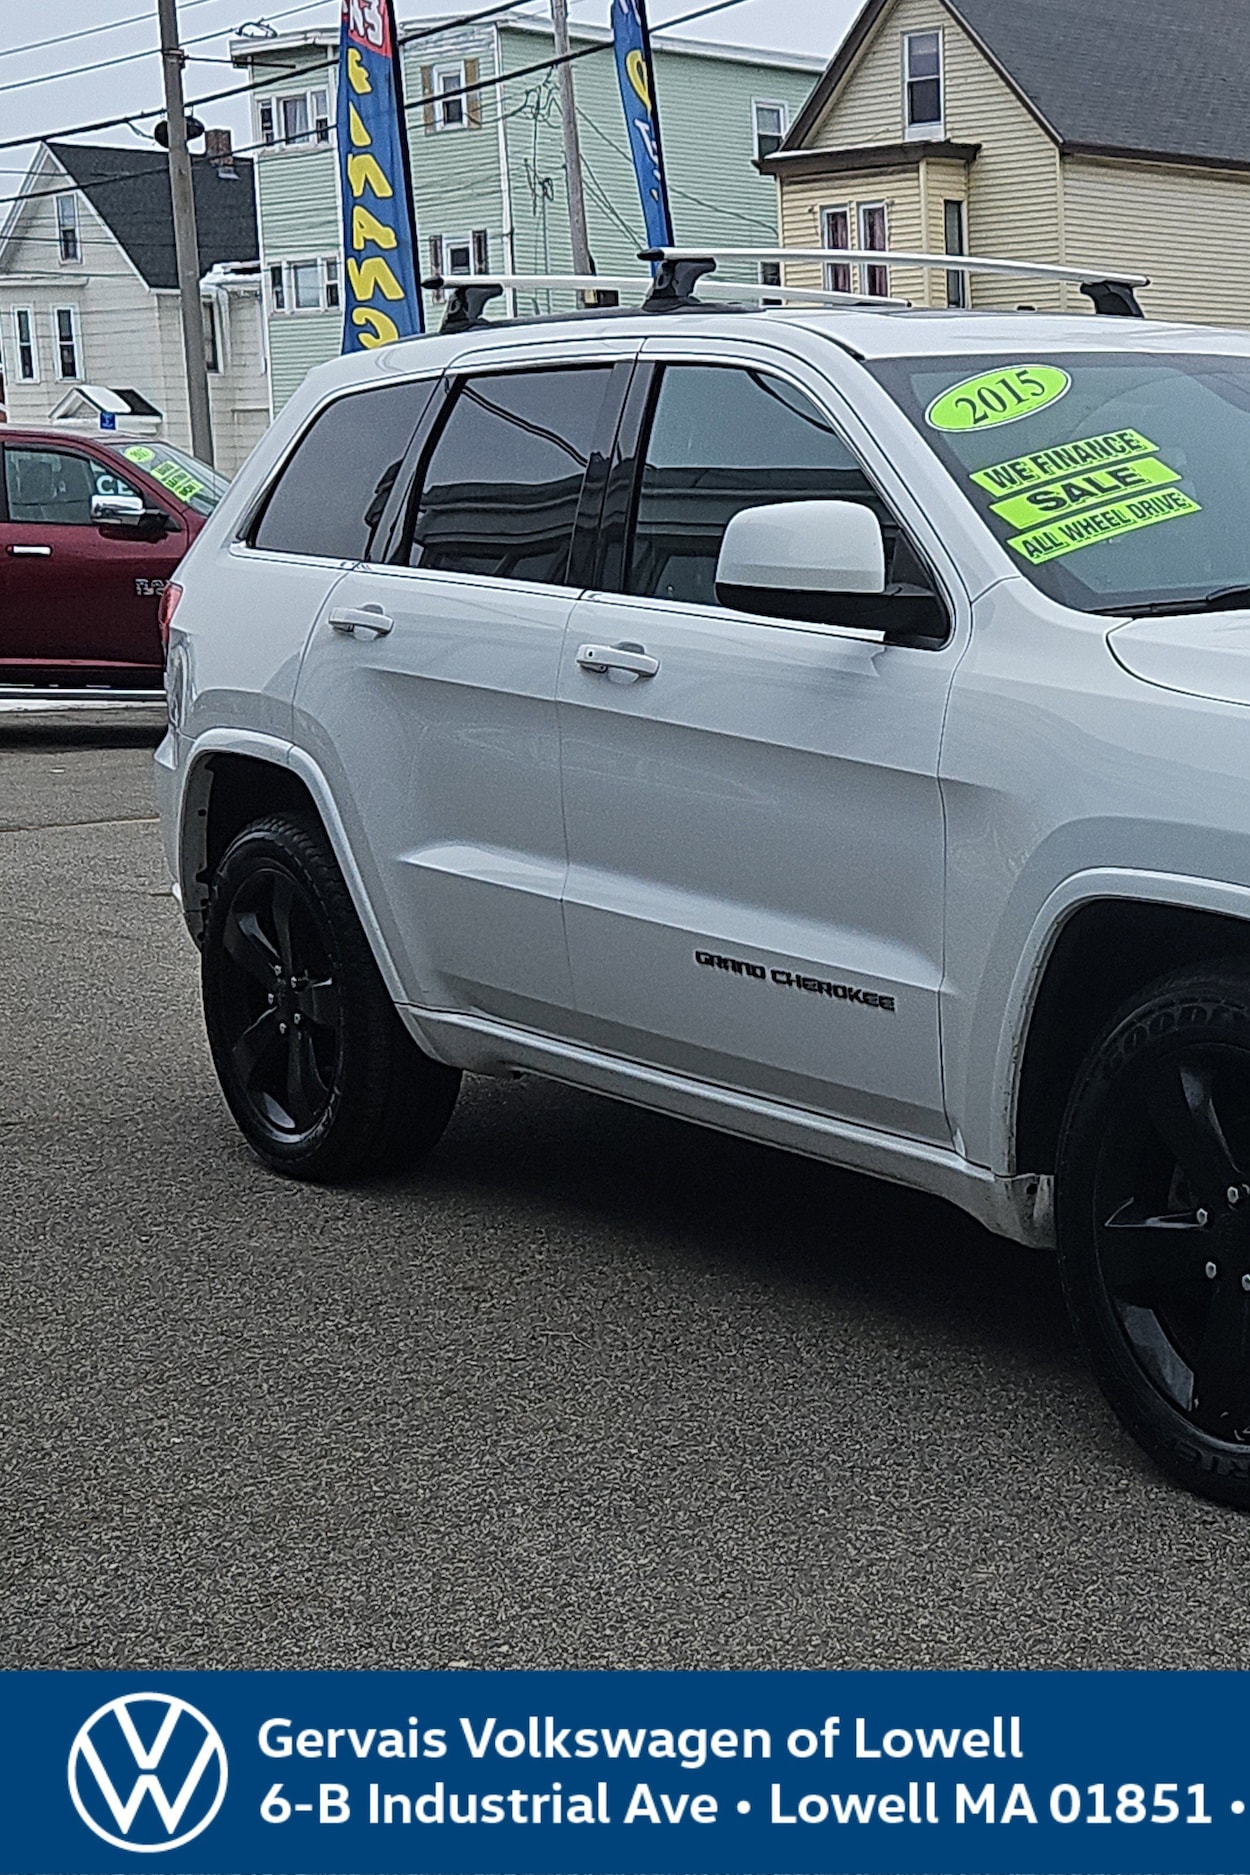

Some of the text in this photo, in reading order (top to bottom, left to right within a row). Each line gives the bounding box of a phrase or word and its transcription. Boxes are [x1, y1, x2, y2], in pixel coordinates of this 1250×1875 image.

[954, 369, 1045, 424] 2015
[984, 432, 1142, 489] WE FINANCE
[1026, 467, 1147, 512] SALE
[1021, 493, 1188, 558] ALL WHEEL DRIVE
[695, 950, 895, 1013] GRAND CHEROKEE
